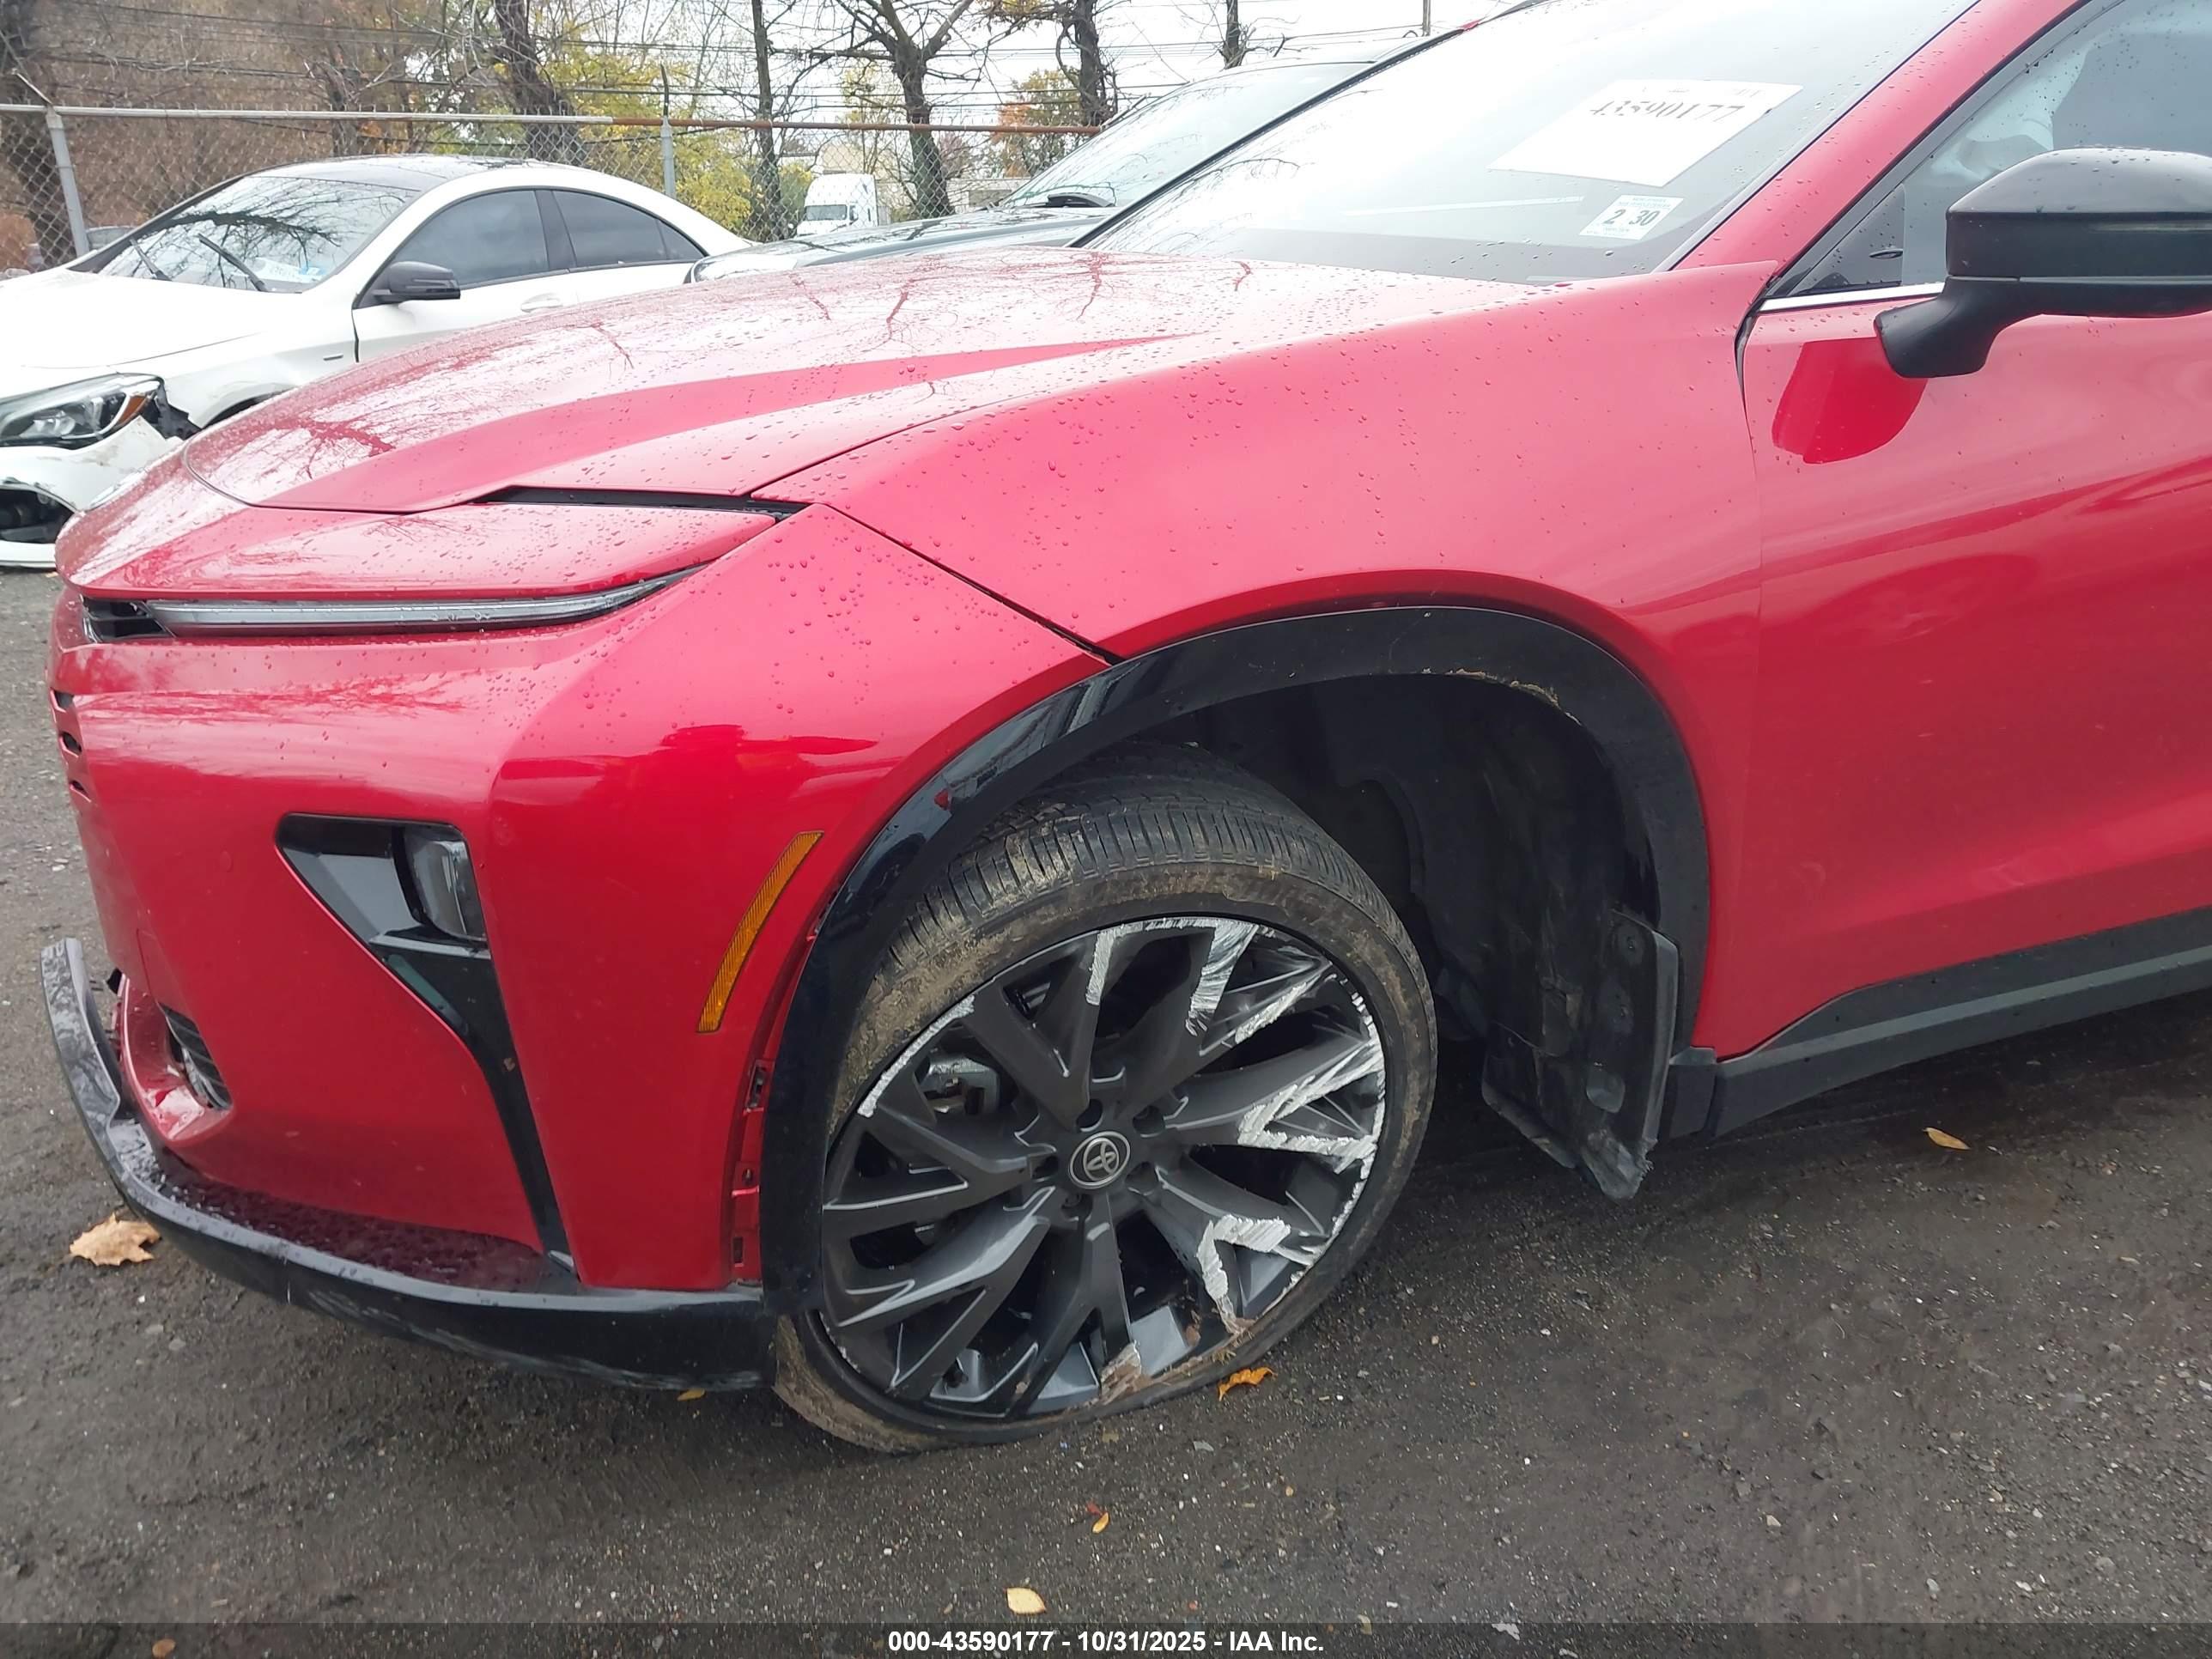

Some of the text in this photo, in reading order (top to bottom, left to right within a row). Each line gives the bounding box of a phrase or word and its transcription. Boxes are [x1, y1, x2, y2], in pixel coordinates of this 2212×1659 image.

[1589, 100, 1746, 122] 43590177
[1602, 209, 1661, 226] 2 30
